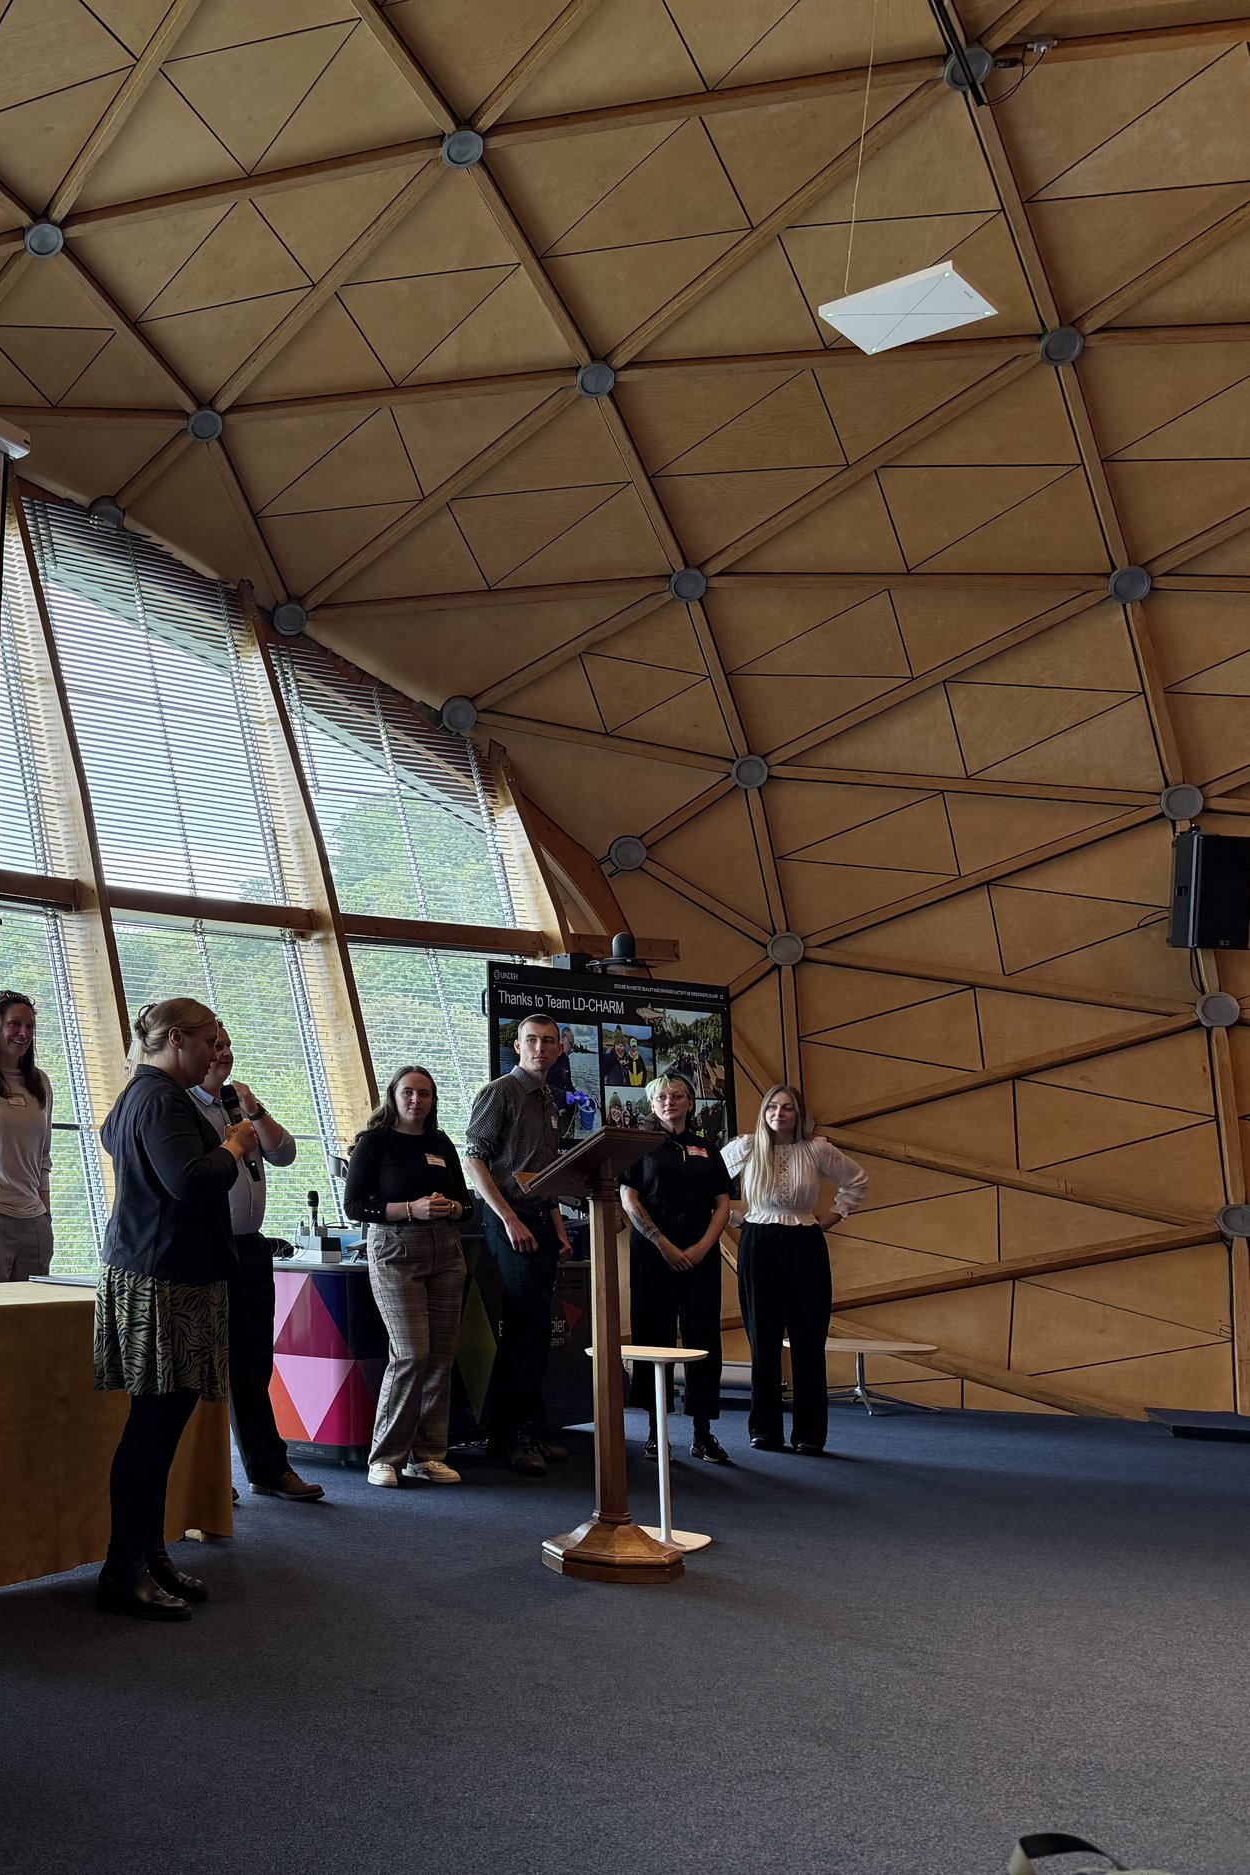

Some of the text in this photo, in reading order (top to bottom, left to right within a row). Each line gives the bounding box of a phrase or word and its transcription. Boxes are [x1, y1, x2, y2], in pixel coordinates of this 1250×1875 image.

[497, 989, 625, 1015] Thanks to Team LD-CHARM
